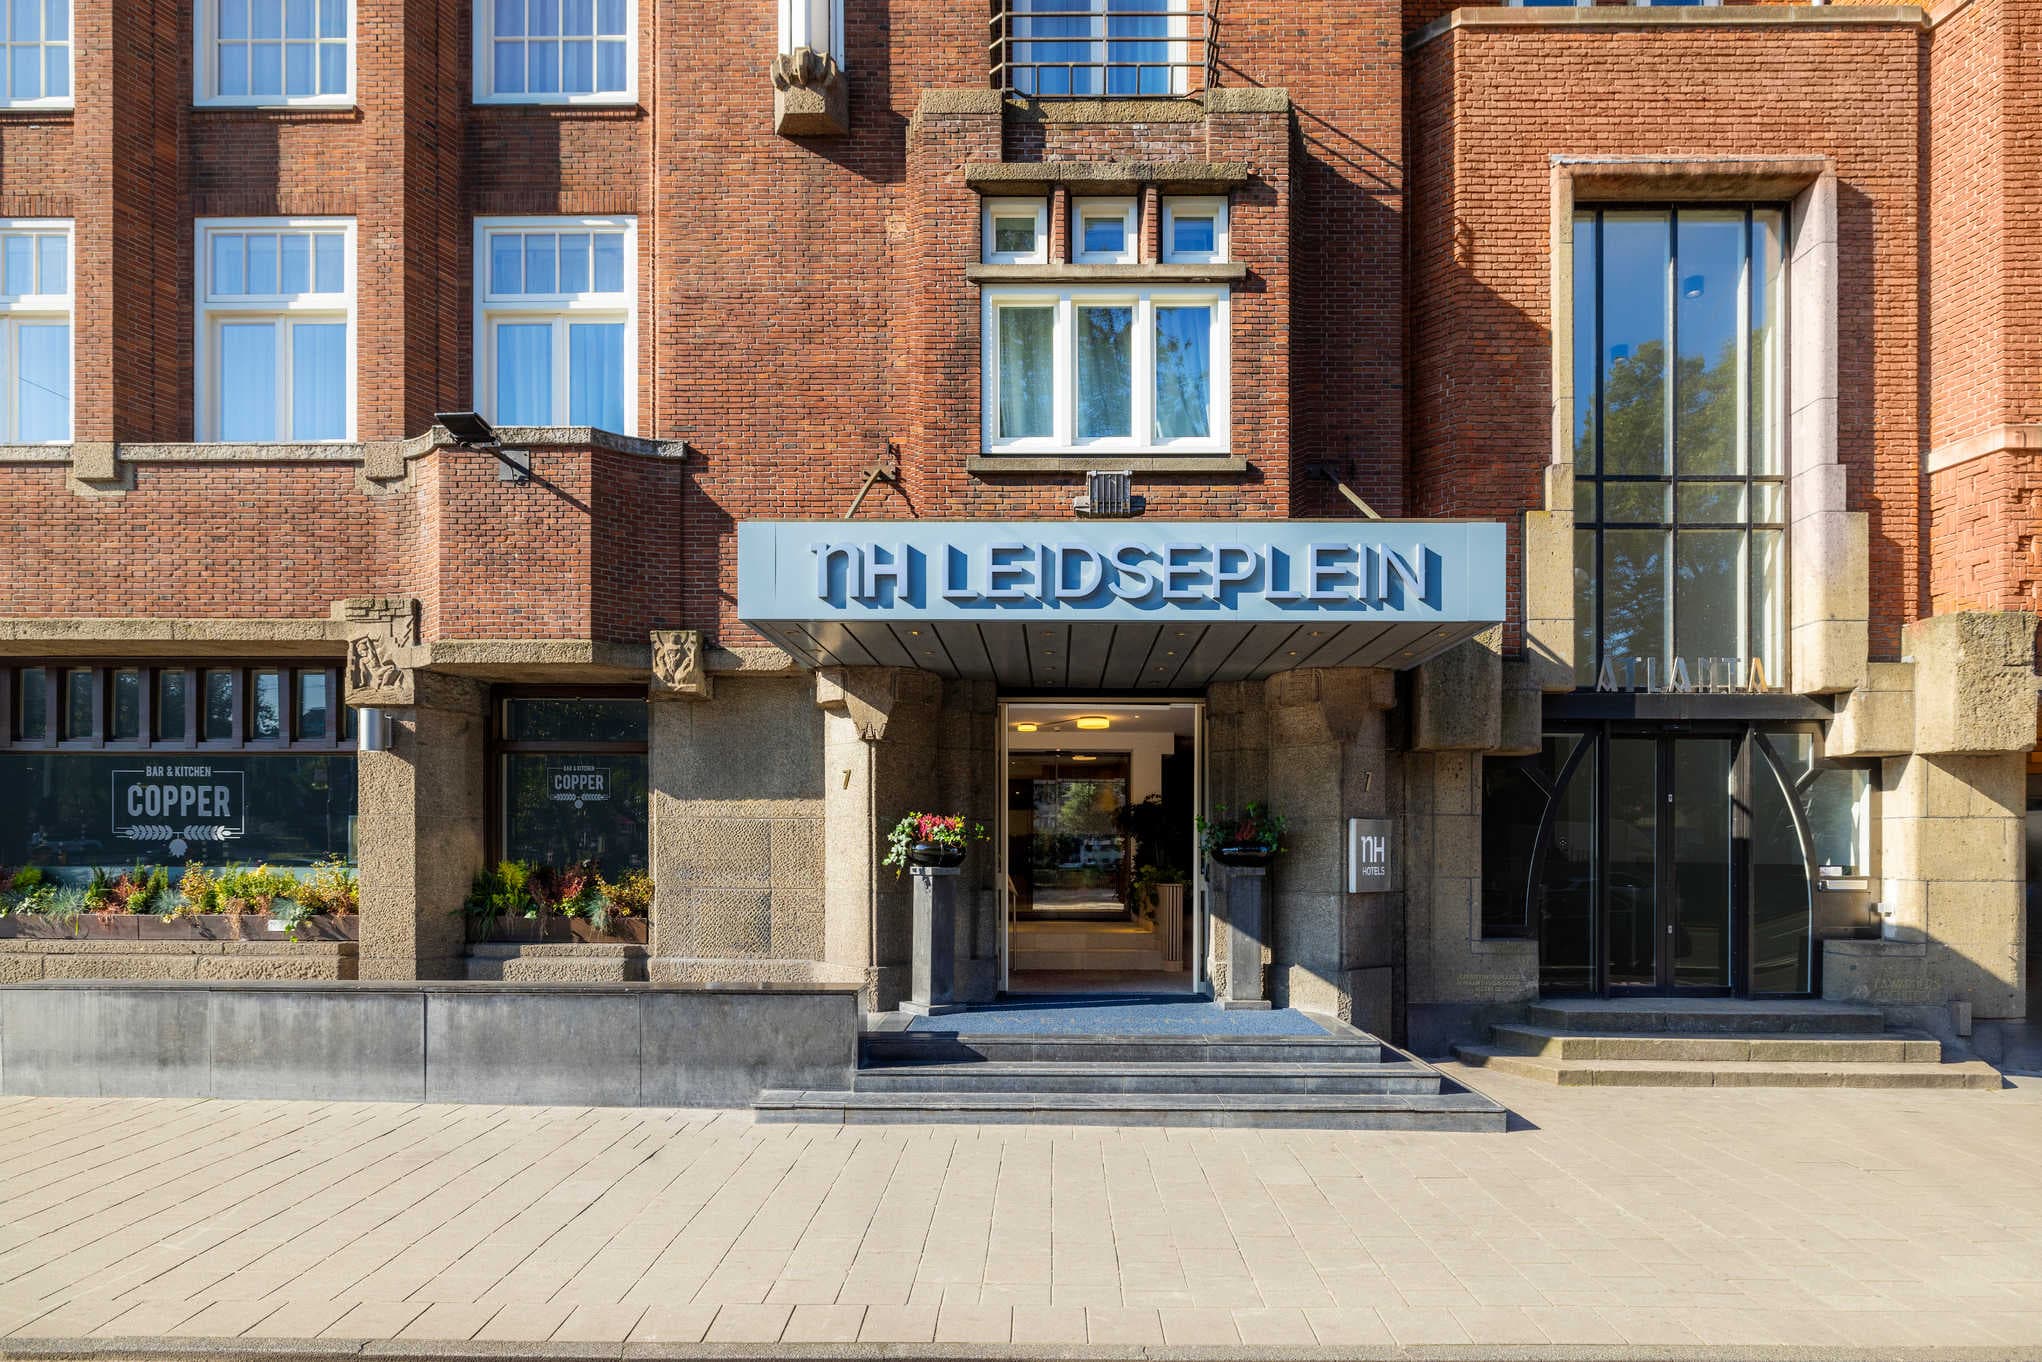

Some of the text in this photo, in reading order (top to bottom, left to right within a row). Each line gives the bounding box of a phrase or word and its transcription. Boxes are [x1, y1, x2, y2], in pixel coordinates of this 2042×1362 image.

[941, 542, 1426, 600] LEIDSEPLEIN
[1596, 655, 1769, 694] ATLANTA
[145, 766, 212, 777] BAR & KITCHEN
[842, 769, 852, 790] 7
[554, 774, 604, 791] COPPER
[127, 784, 231, 817] COPPER
[1362, 866, 1385, 876] HOTELS
